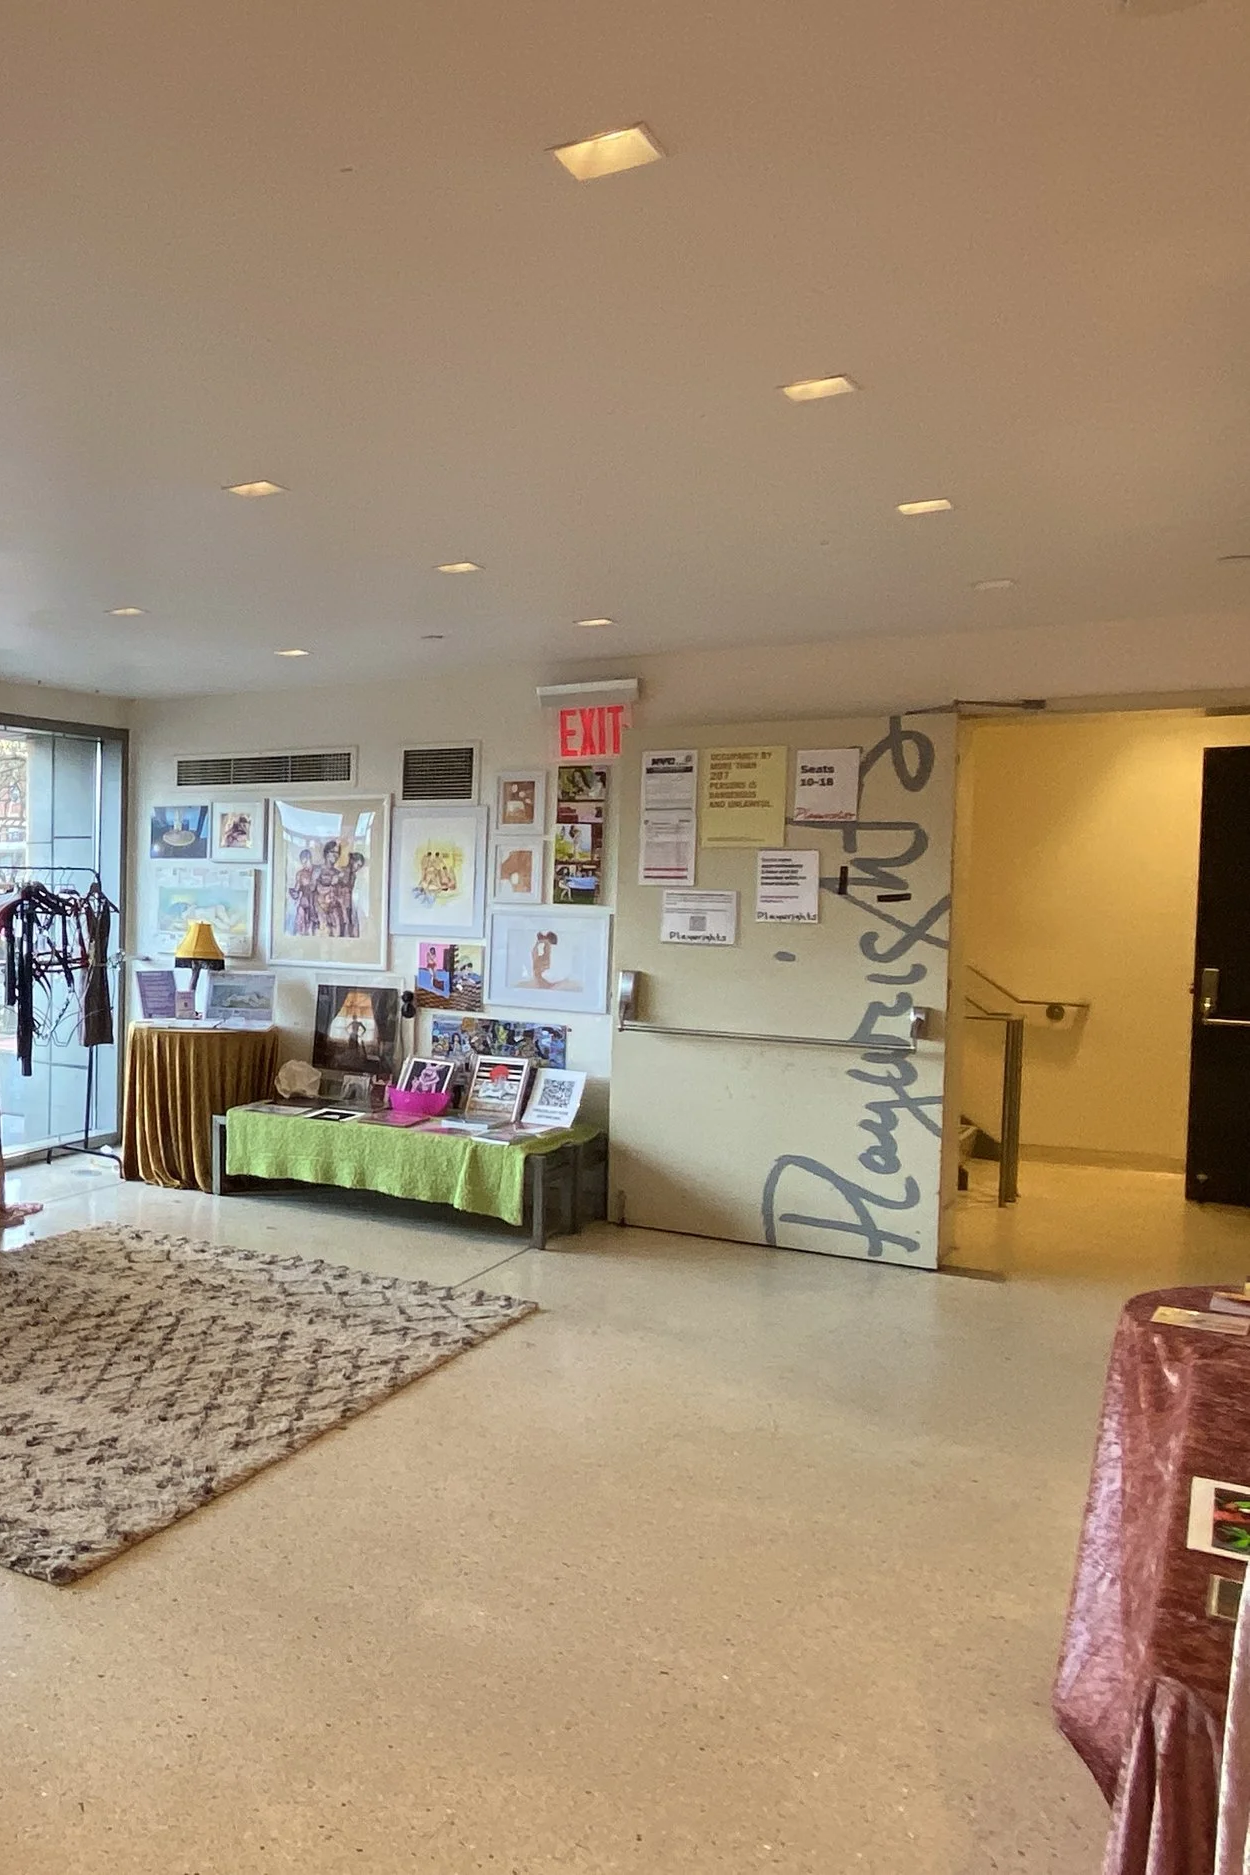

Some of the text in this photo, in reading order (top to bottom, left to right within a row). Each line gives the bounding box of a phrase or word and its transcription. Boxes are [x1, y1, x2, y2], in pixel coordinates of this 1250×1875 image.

[560, 706, 624, 756] EXIT
[710, 751, 772, 761] OCCUPANCY BY
[801, 765, 835, 774] Seats
[800, 777, 834, 787] 10-18
